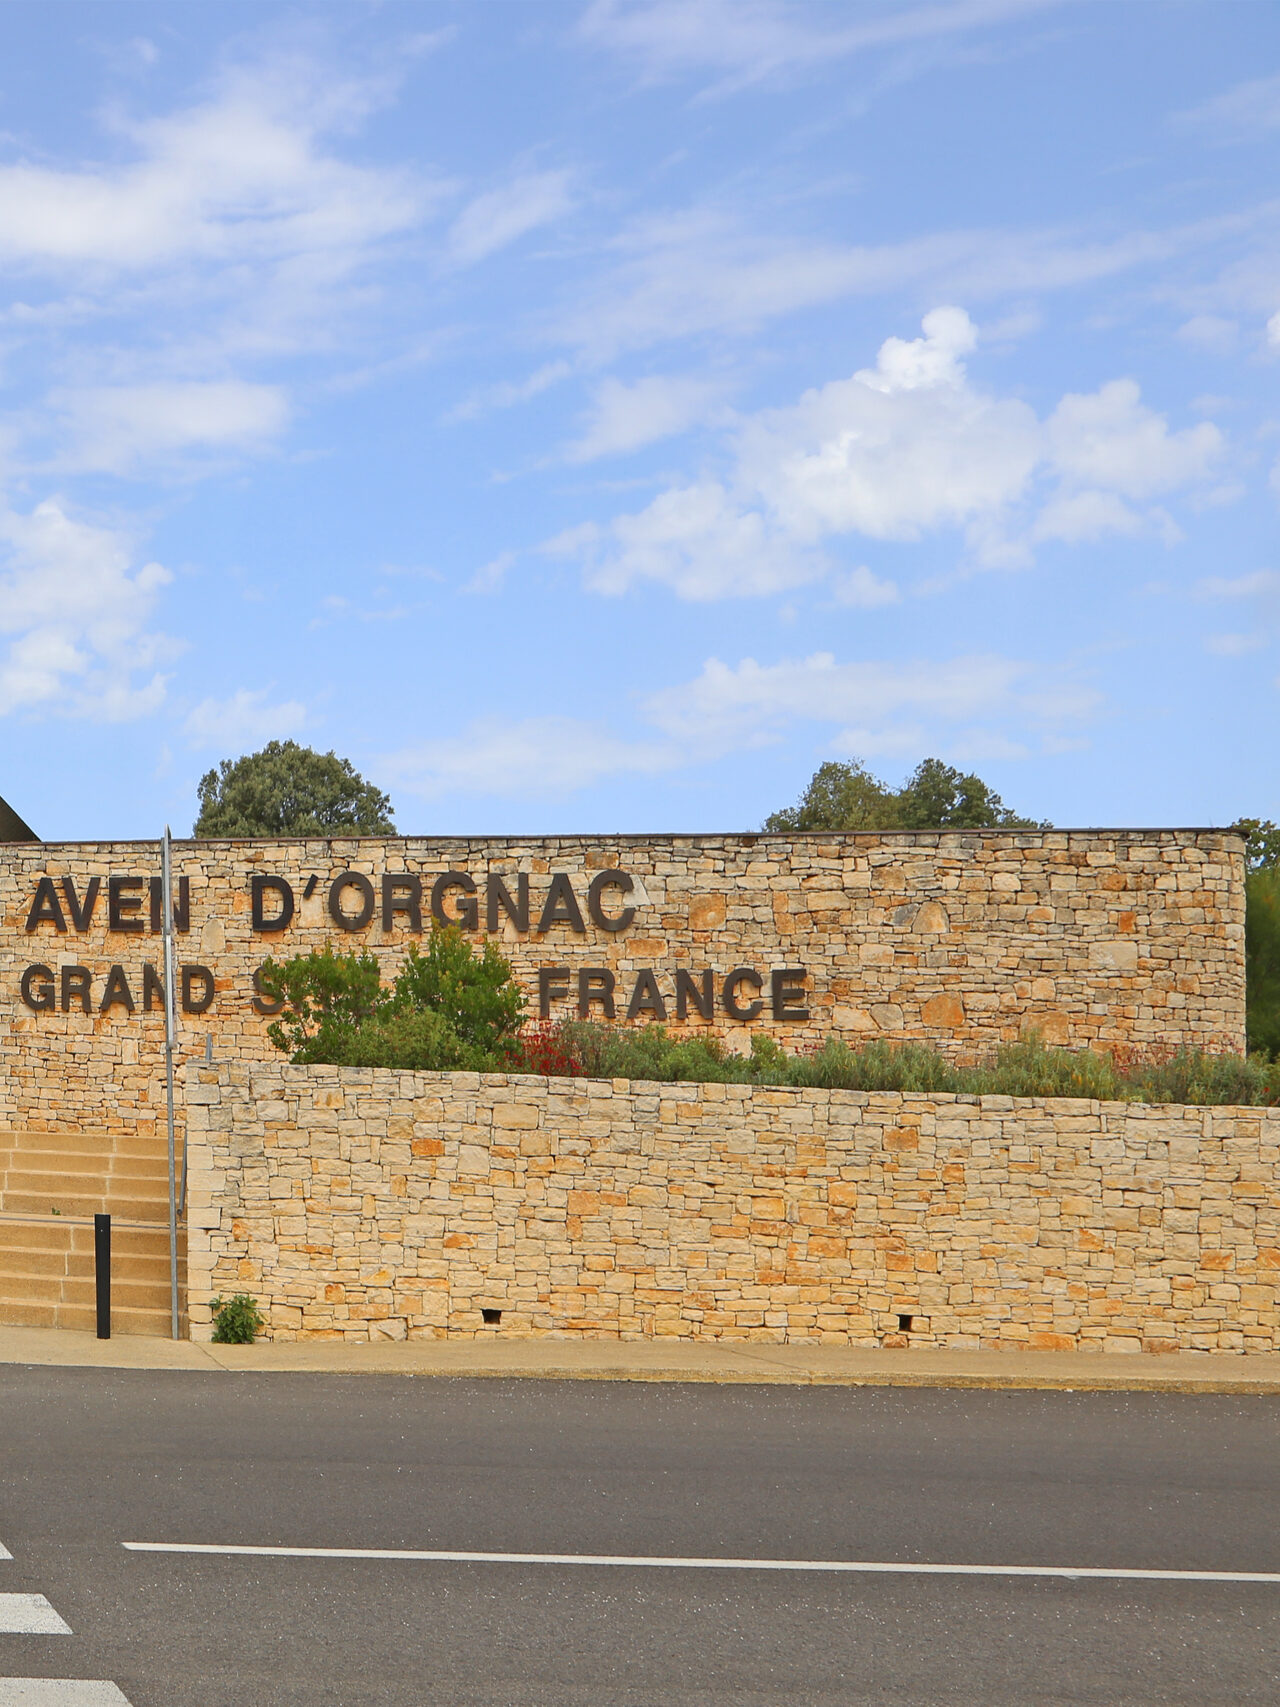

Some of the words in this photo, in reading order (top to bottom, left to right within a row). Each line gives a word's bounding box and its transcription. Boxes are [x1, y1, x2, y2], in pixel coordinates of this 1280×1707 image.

[25, 875, 190, 931] AVEN
[251, 869, 636, 932] D'ORGNAC
[21, 964, 215, 1012] GRAND
[539, 967, 809, 1020] FRANCE
